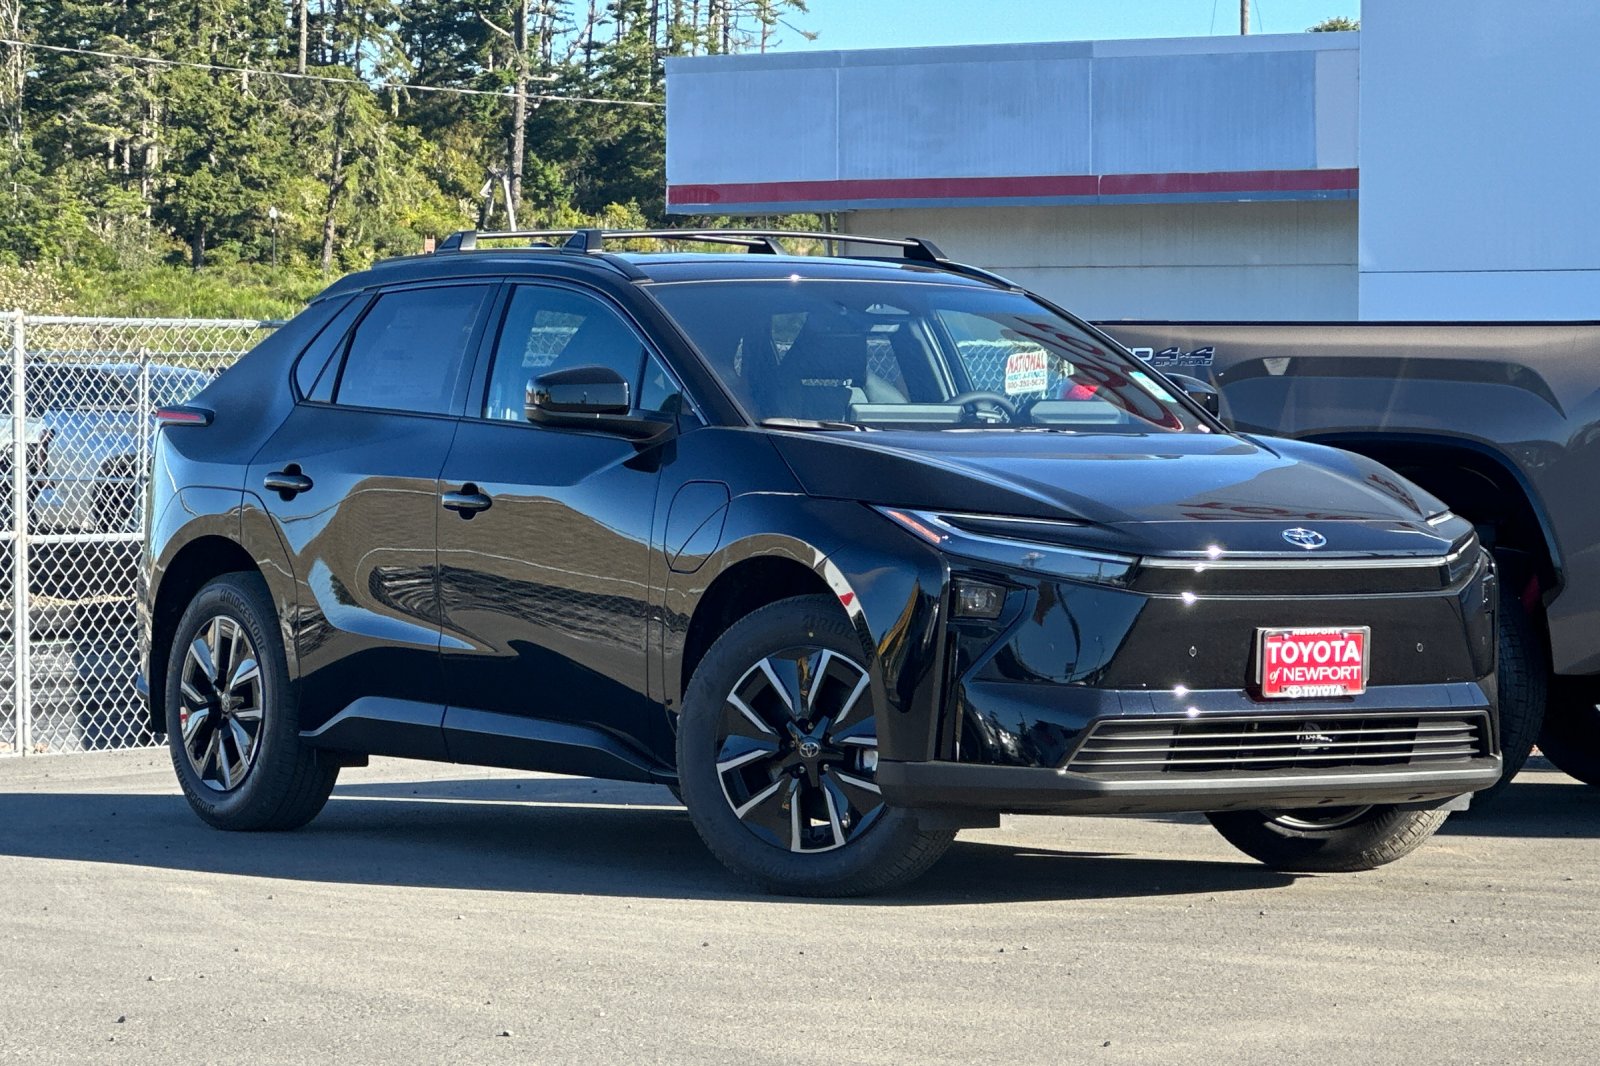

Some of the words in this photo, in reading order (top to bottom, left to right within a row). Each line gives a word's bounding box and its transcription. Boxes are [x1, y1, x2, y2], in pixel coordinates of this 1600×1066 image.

[1007, 352, 1046, 374] NATIONAL
[220, 588, 266, 653] BRIDGESTONE
[1267, 641, 1361, 664] TOYOTA
[1270, 667, 1282, 684] of
[1283, 666, 1361, 681] NEWPORT
[1303, 685, 1344, 696] TOYOTA
